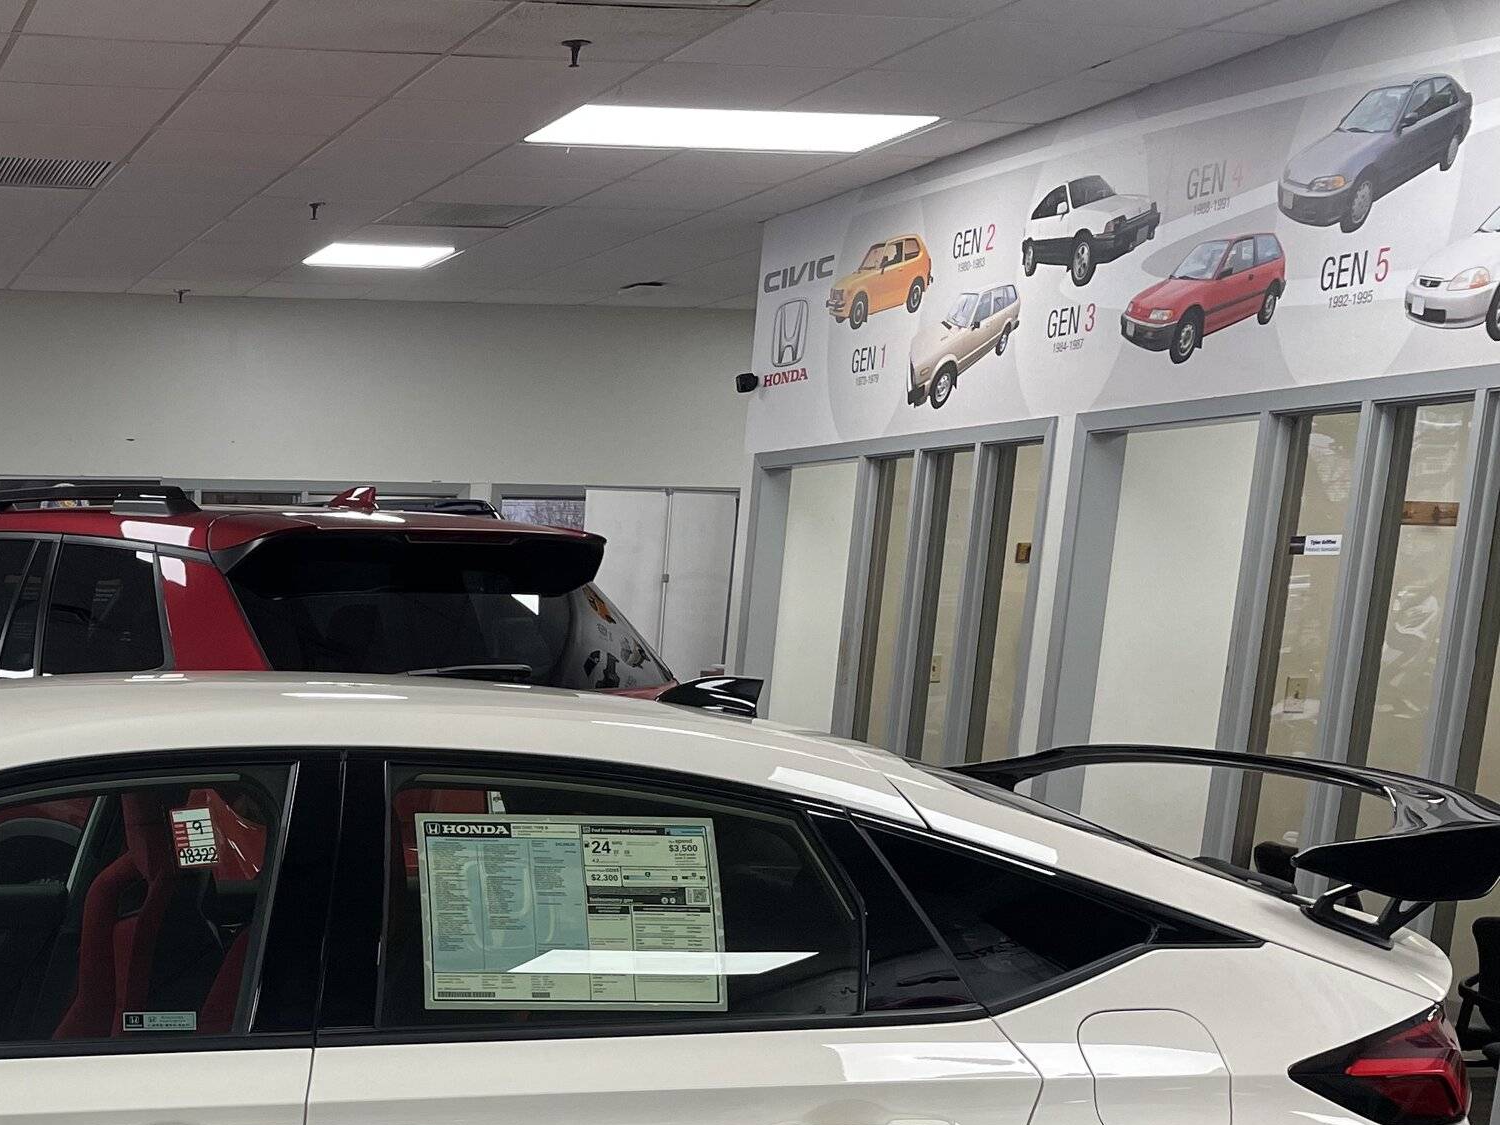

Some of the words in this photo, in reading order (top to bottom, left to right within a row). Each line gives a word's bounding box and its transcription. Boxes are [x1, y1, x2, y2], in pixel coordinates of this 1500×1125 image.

[1187, 162, 1227, 200] GEN
[952, 226, 982, 259] GEN
[985, 223, 996, 251] 2
[763, 254, 835, 293] CIVIC
[1320, 250, 1369, 292] GEN
[1375, 246, 1391, 283] 5
[1328, 289, 1374, 310] 1992-1995
[1047, 304, 1081, 339] GEN
[1084, 302, 1096, 332] 3
[851, 345, 876, 374] GEN
[881, 343, 887, 369] 1
[762, 367, 808, 388] HONDA
[192, 820, 204, 834] 9
[442, 824, 510, 835] HONDA
[591, 840, 612, 854] 24
[668, 844, 698, 853] $3,500
[590, 873, 619, 882] $2,300
